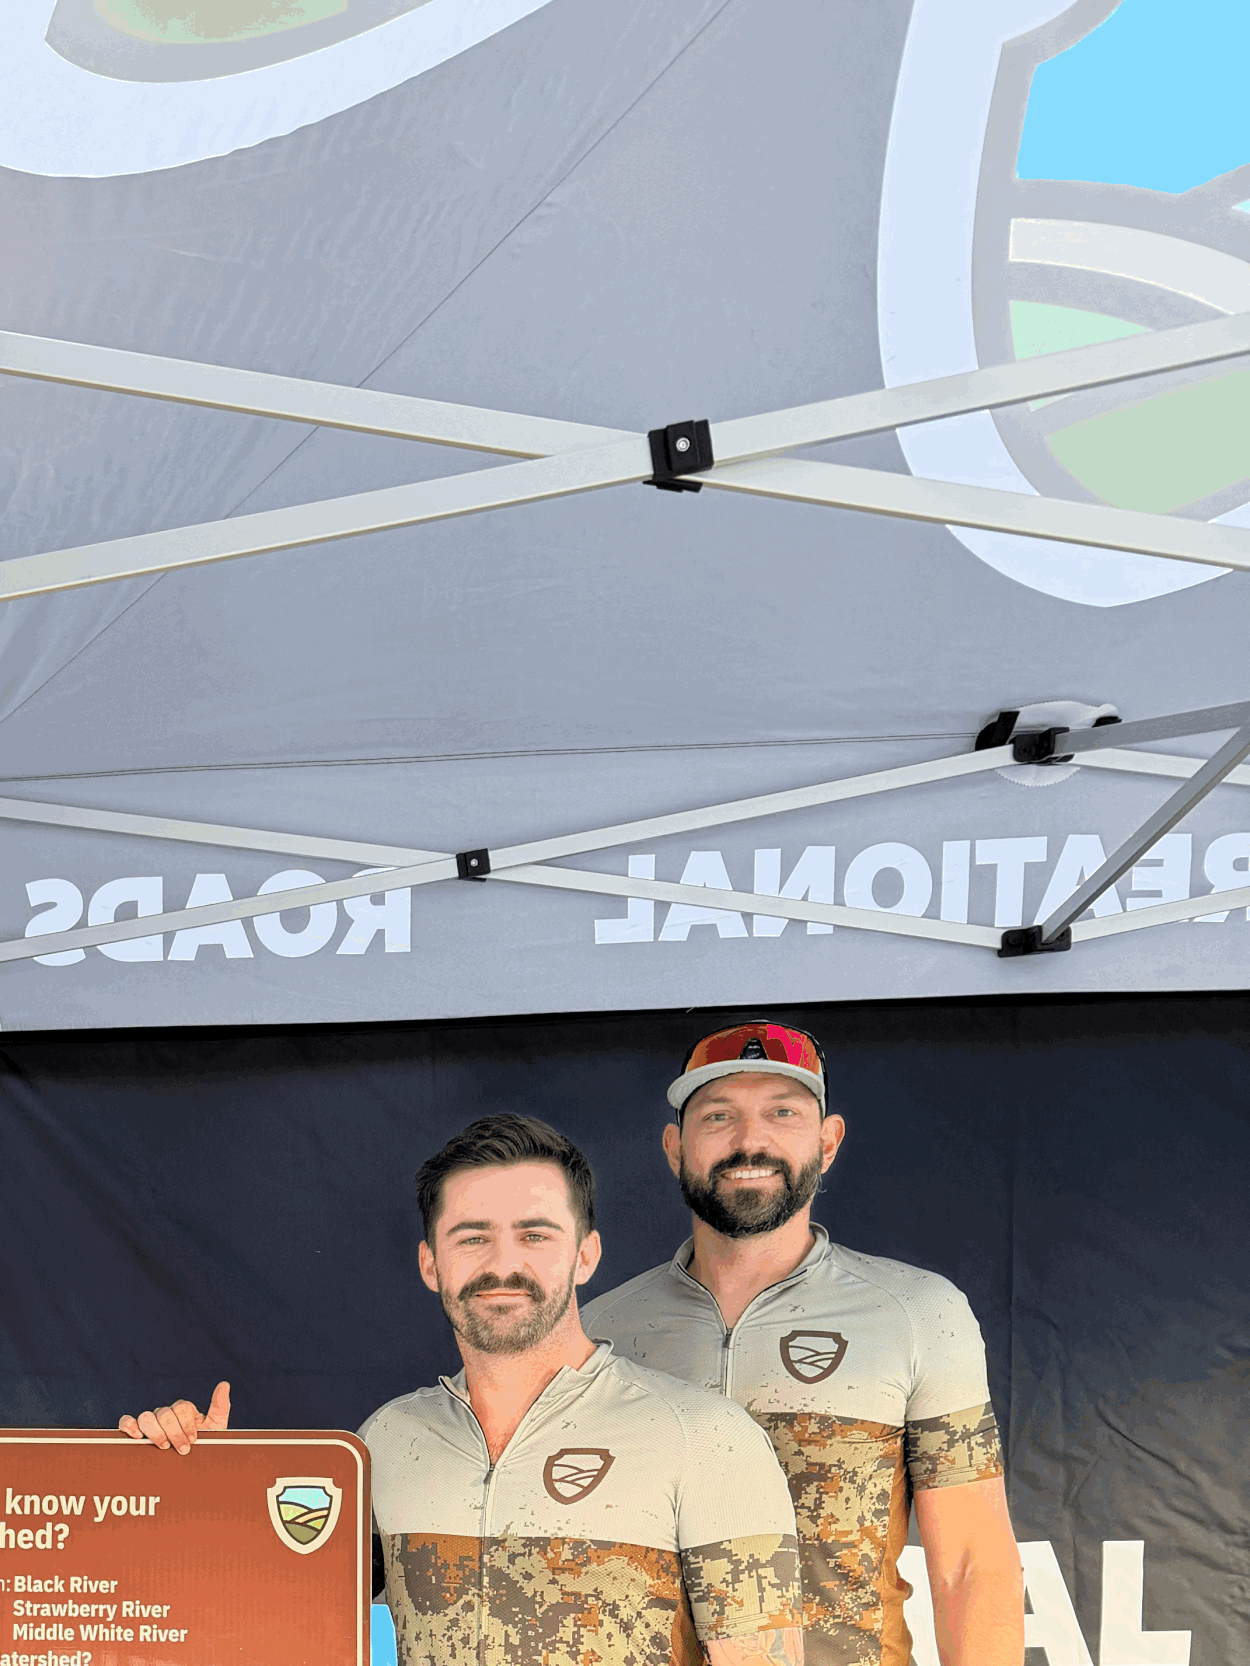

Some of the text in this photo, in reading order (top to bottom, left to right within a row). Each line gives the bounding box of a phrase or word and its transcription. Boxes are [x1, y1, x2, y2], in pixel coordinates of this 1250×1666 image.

[5, 1487, 85, 1515] know
[92, 1495, 160, 1522] your
[14, 1575, 64, 1592] Black
[69, 1575, 118, 1593] River
[12, 1599, 170, 1621] Strawberry River
[12, 1622, 188, 1642] Middle White River
